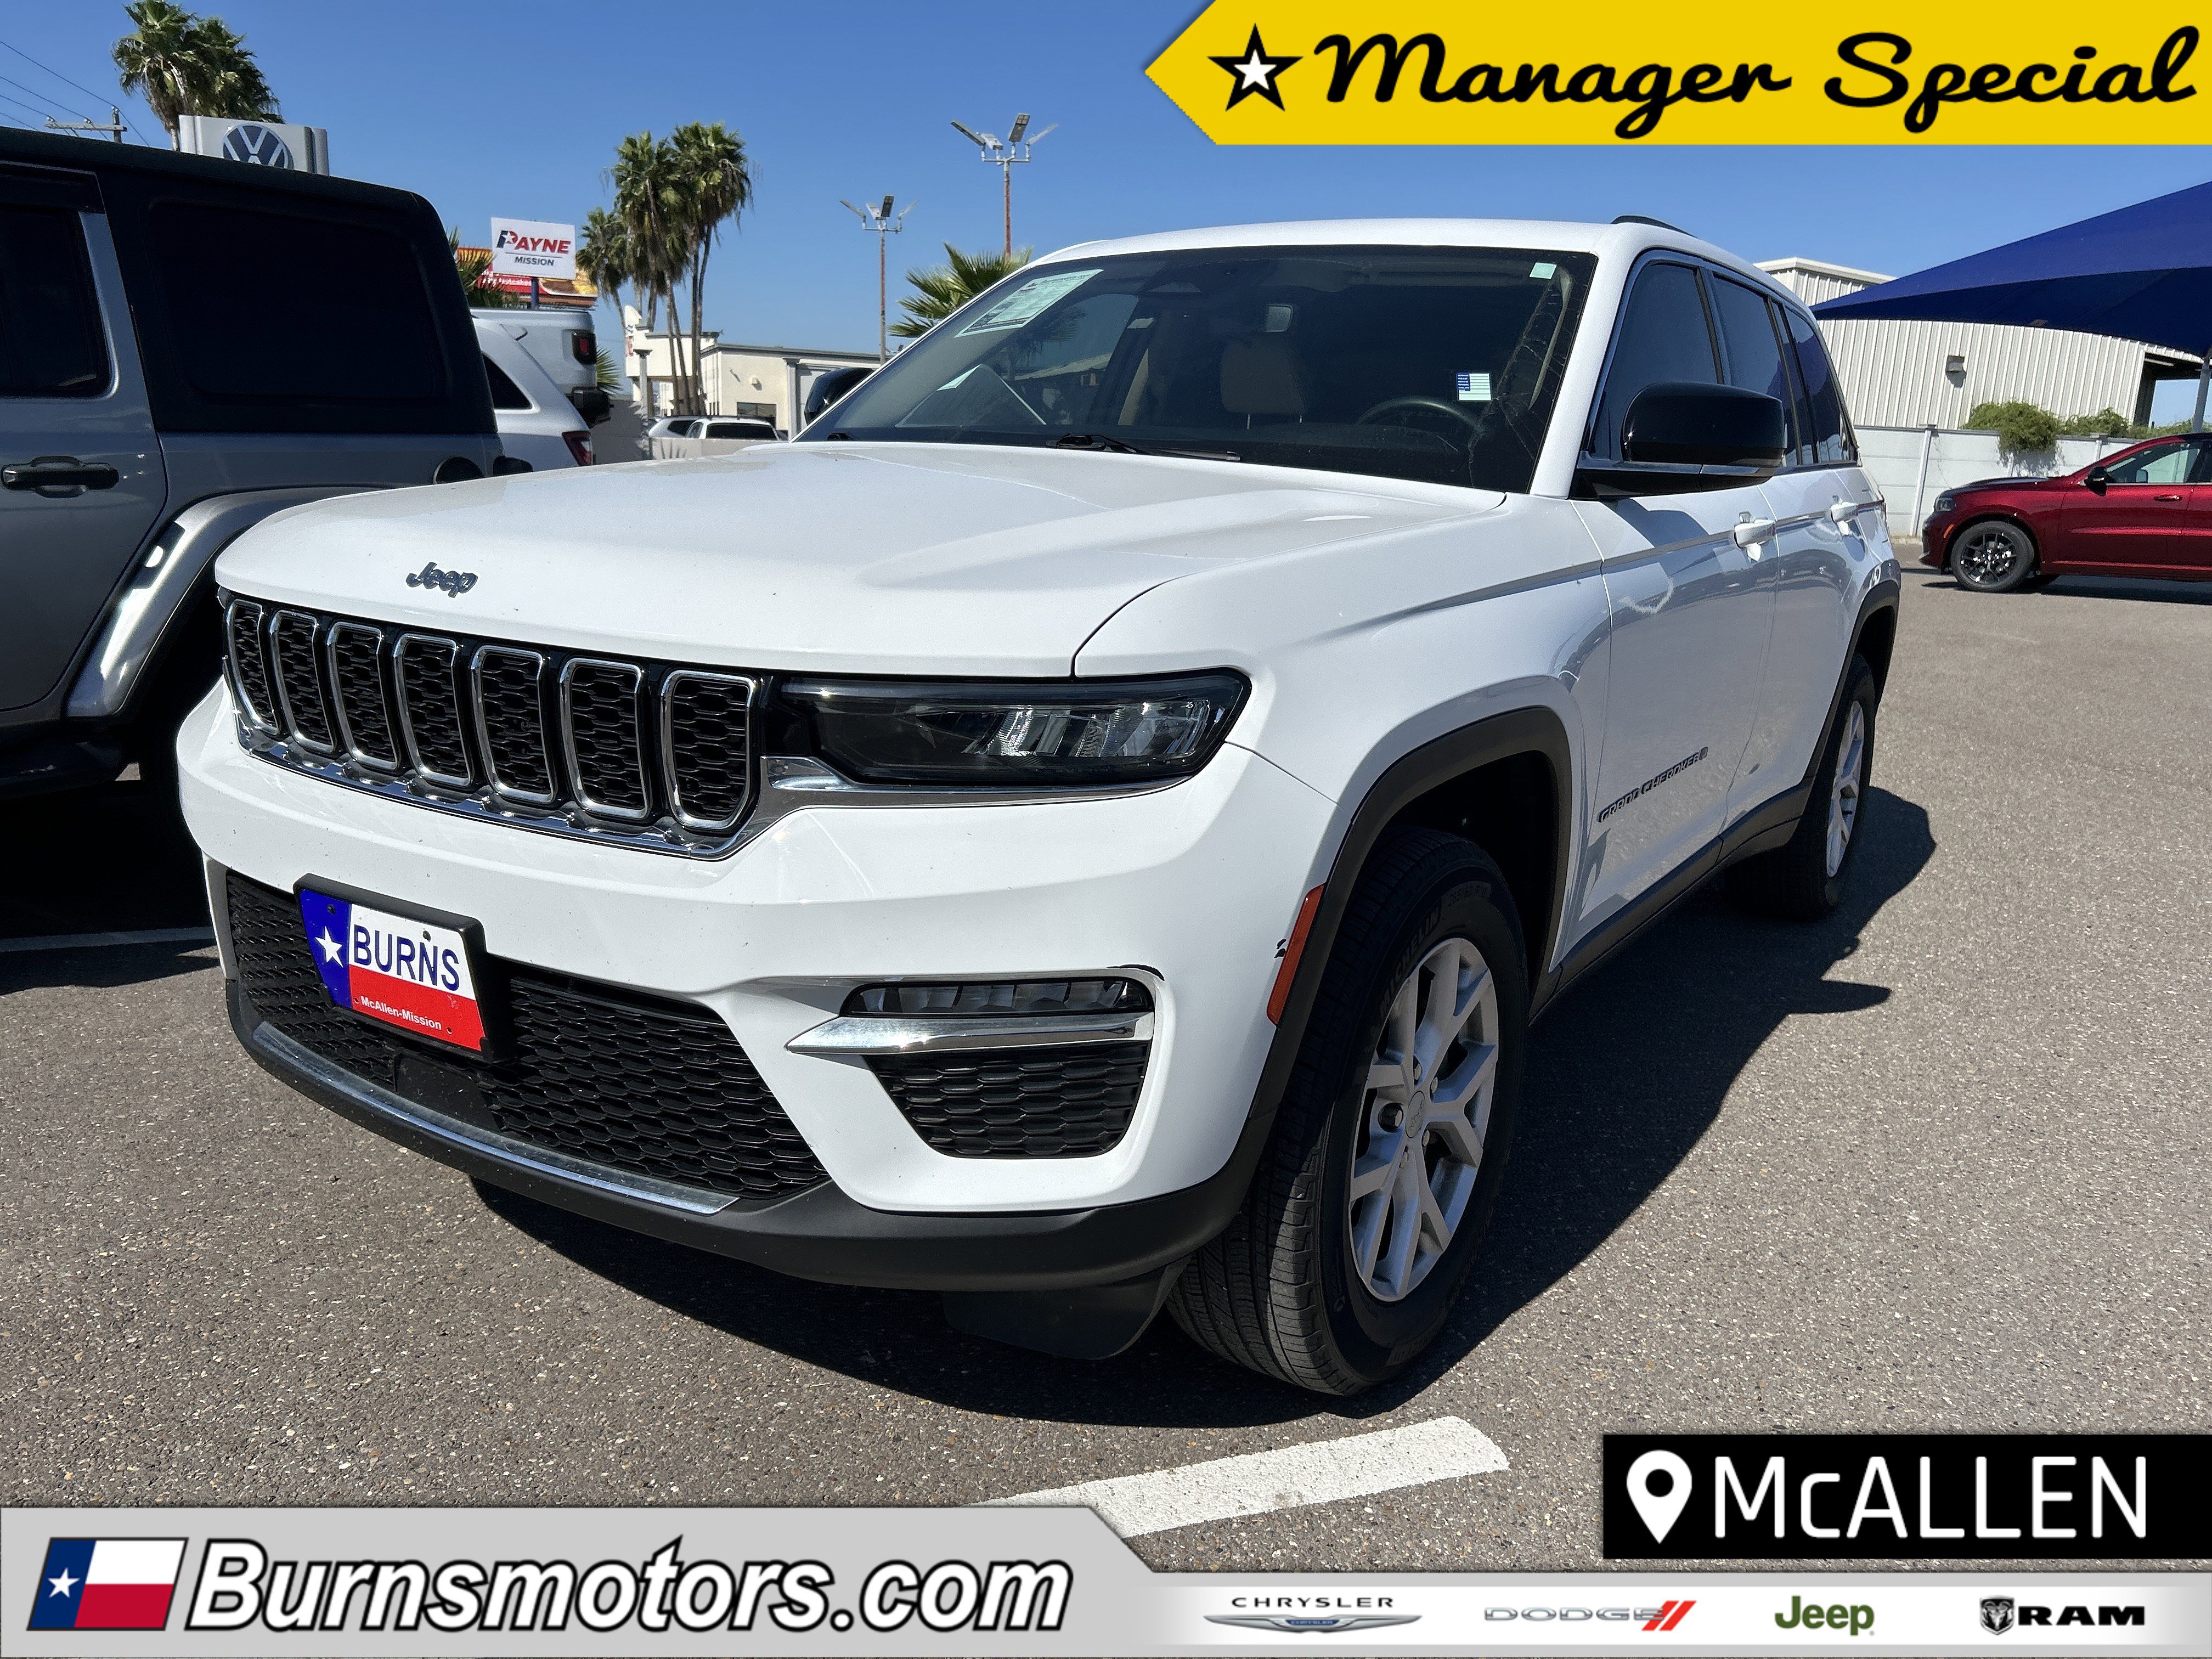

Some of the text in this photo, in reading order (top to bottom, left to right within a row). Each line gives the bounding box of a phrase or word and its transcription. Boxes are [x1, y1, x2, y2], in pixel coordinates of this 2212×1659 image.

[496, 230, 571, 255] PAYNE
[515, 256, 555, 266] MISSION
[405, 562, 478, 598] Jeep
[1596, 787, 1640, 823] GRAND
[353, 924, 460, 991] BURNS
[360, 995, 442, 1031] McAllen-Mission
